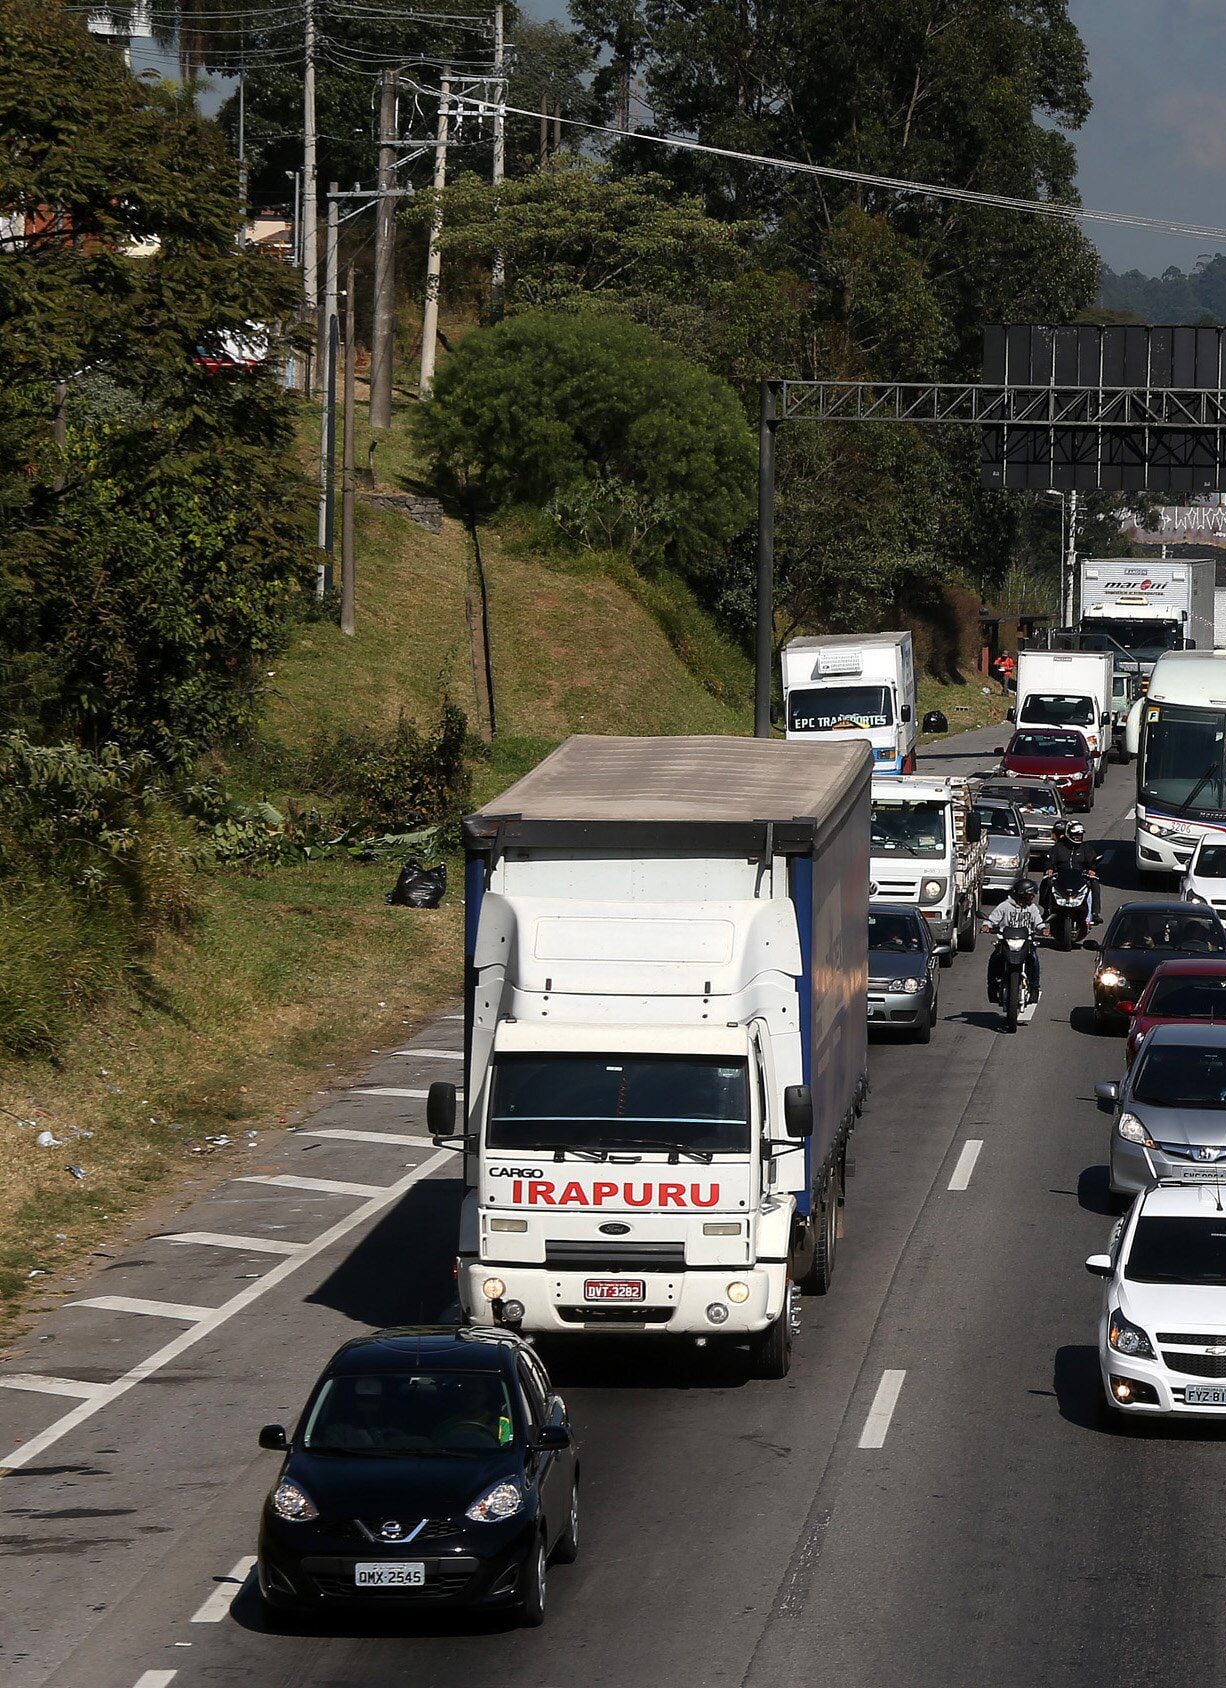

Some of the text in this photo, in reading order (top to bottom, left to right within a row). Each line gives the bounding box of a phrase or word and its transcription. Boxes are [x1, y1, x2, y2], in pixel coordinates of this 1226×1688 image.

[795, 718, 815, 729] EPC
[489, 1167, 544, 1179] CARGO
[512, 1180, 720, 1207] IRAPURU
[588, 1286, 640, 1297] DVT-3282
